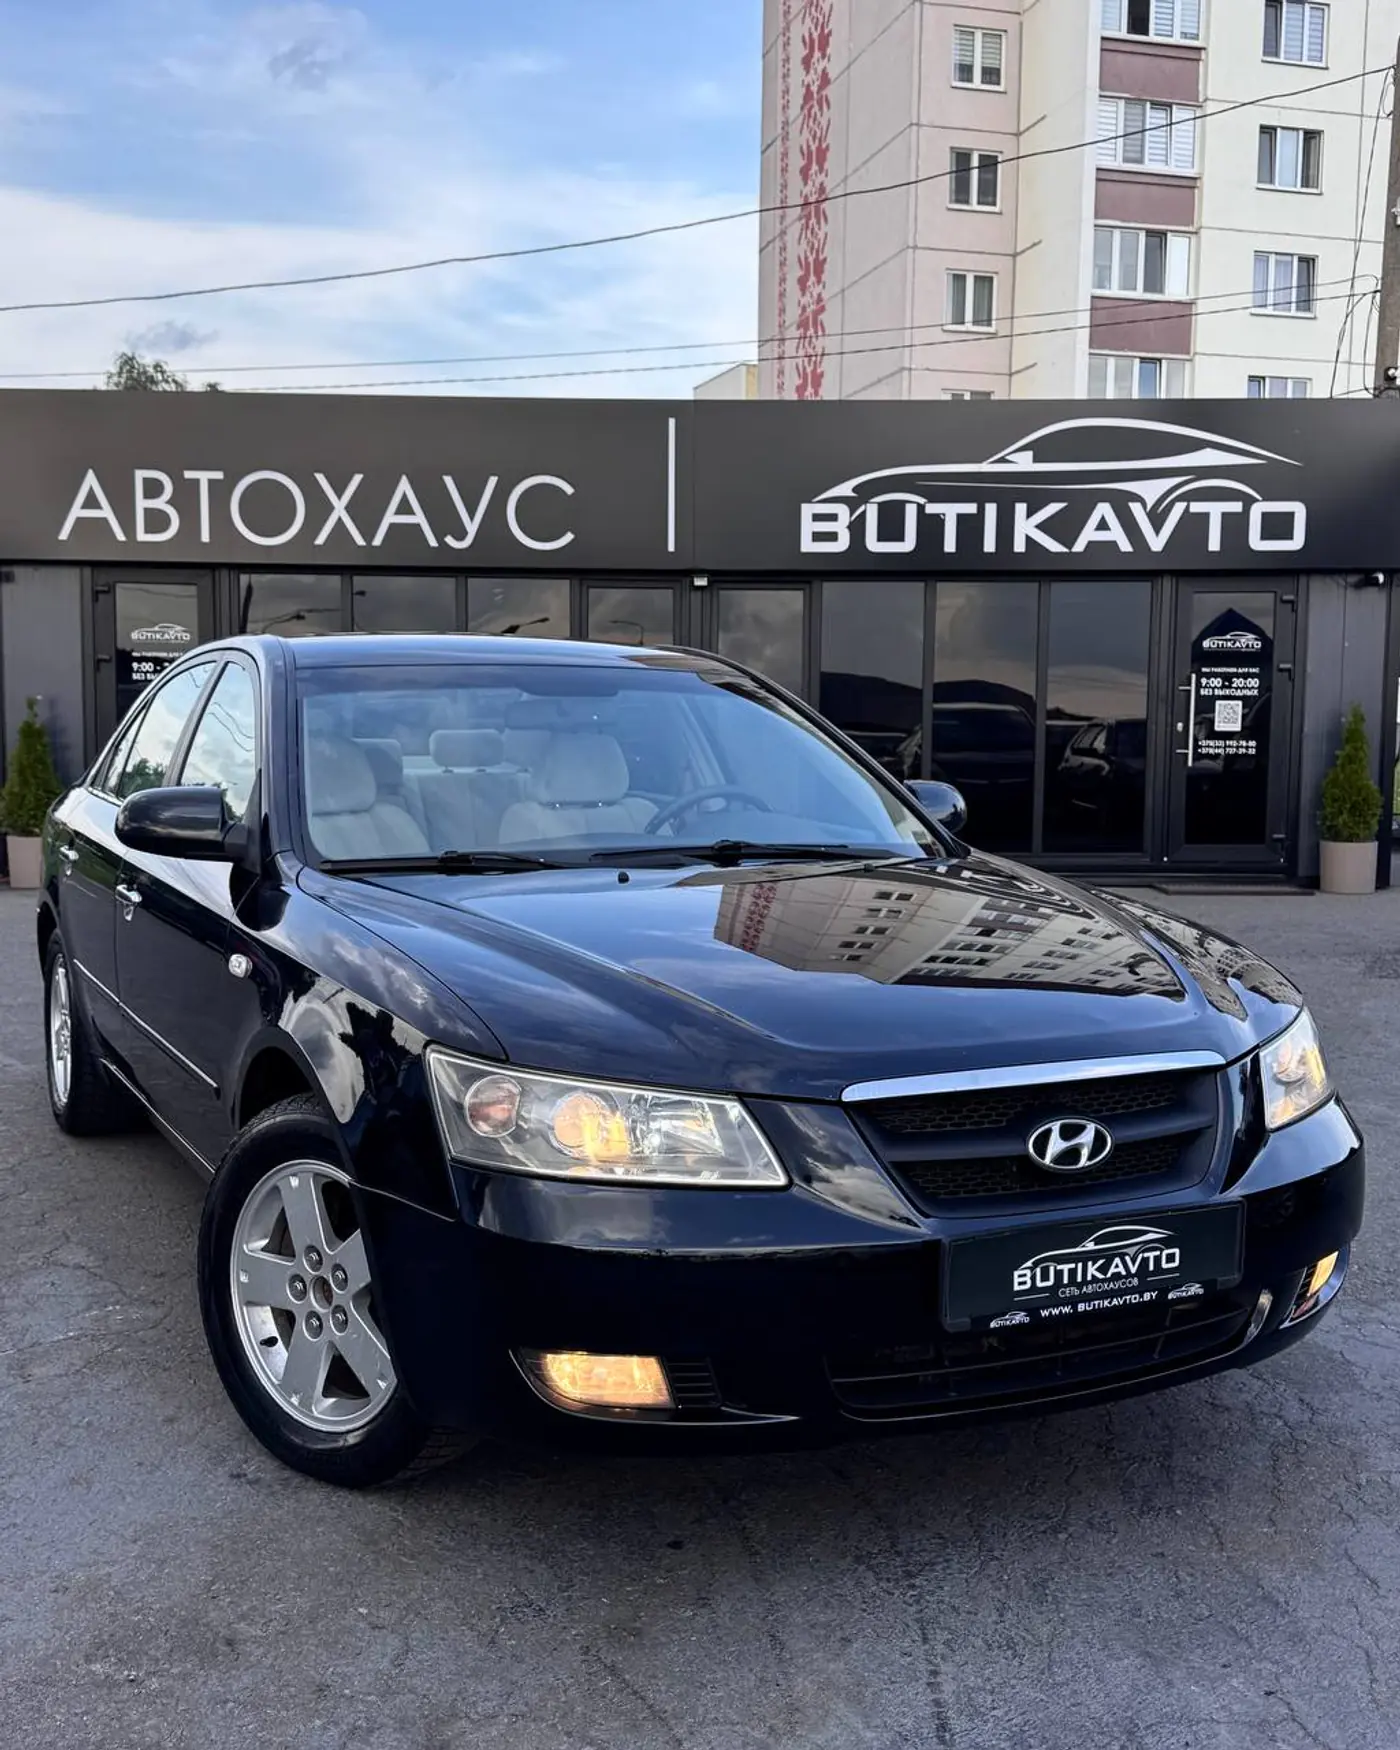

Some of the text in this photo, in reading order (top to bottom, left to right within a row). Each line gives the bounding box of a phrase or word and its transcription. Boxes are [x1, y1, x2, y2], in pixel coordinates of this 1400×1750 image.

[58, 468, 576, 551] АВТОХАУС
[800, 501, 1307, 554] BUTIKAVTO
[131, 632, 190, 640] BUTIKAVTO
[1202, 639, 1262, 648] BUTIKAVTO
[132, 662, 154, 672] 9:00
[1200, 677, 1222, 687] 9:00
[1231, 677, 1260, 688] 20:00
[1013, 1248, 1180, 1291] BUTIKAVTO
[1058, 1277, 1139, 1298] СЕТЬ АВТОХАУСОВ
[1077, 1291, 1158, 1312] BUTIKAVTO.BY
